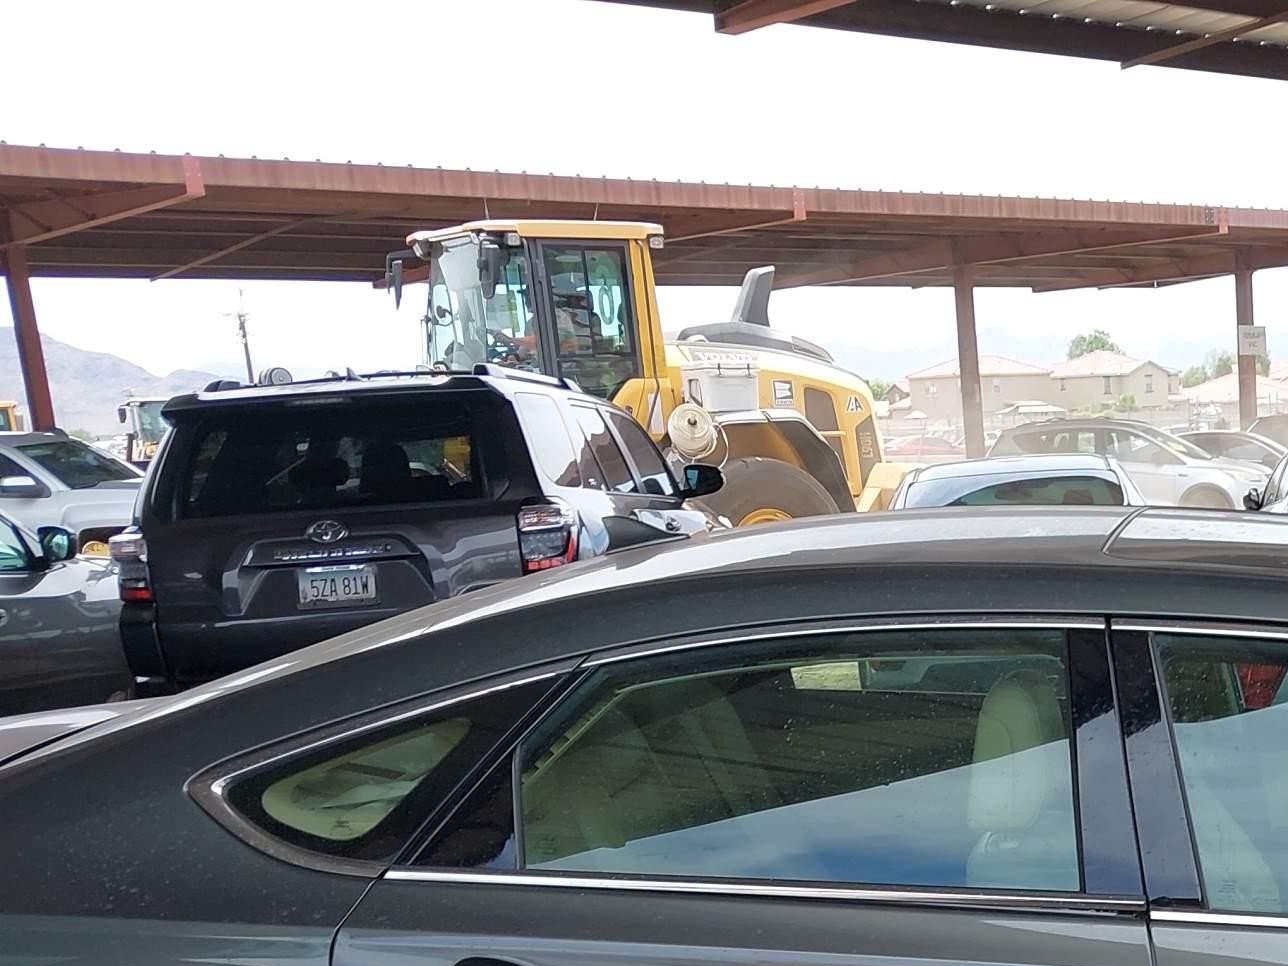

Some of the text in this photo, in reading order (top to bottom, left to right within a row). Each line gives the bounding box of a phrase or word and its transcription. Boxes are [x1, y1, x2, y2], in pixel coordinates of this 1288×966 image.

[697, 351, 754, 362] VOLVO
[310, 575, 369, 598] 5ZA 81W
